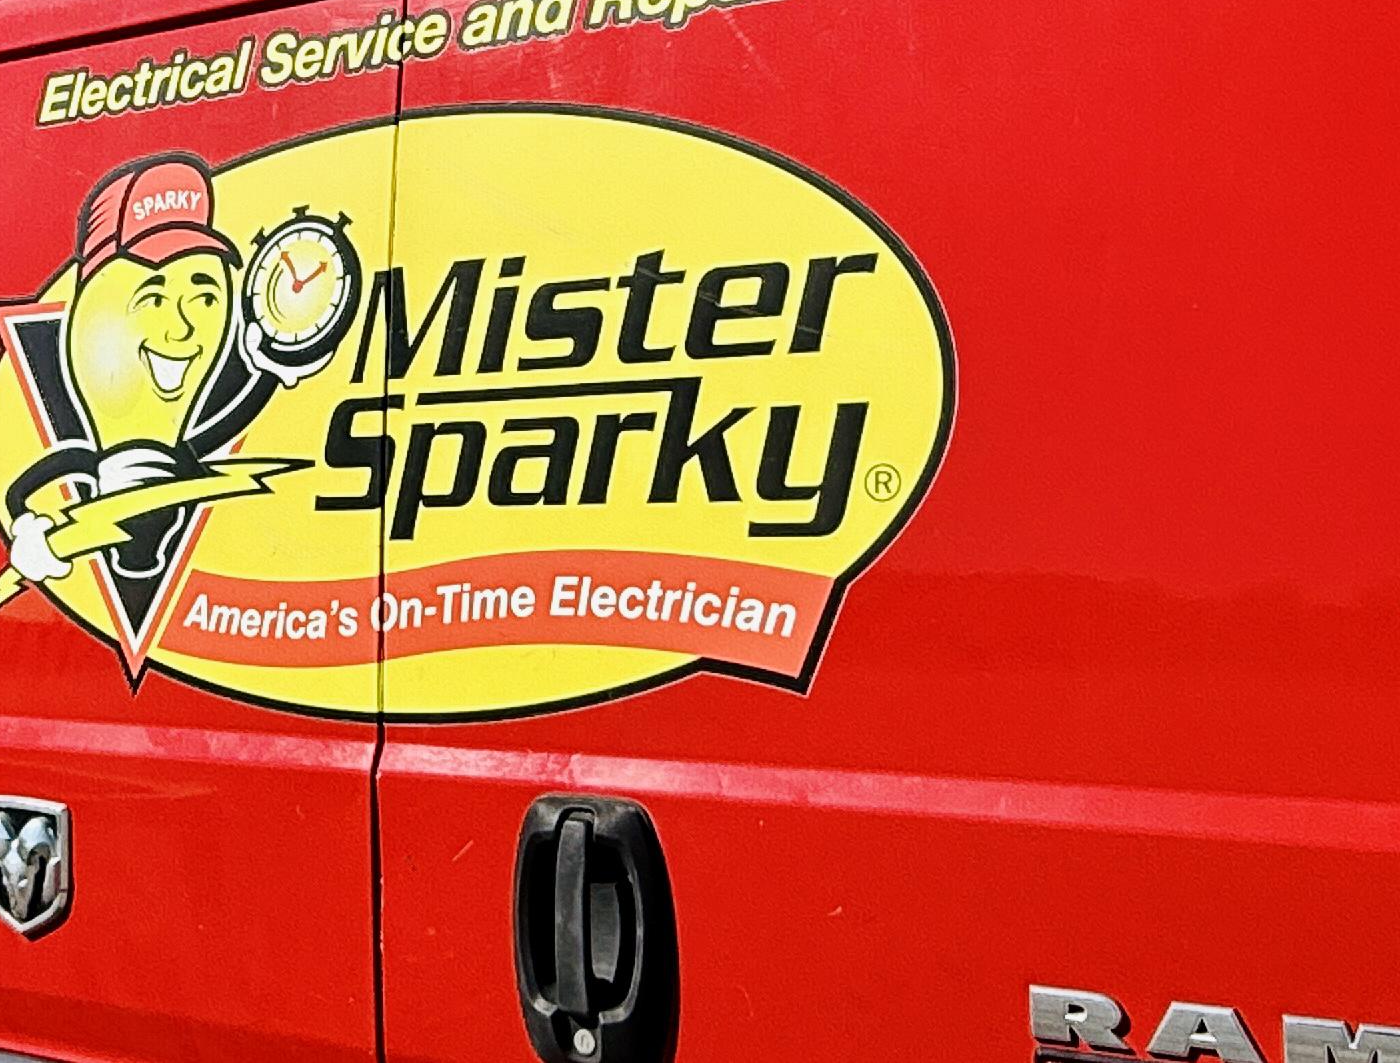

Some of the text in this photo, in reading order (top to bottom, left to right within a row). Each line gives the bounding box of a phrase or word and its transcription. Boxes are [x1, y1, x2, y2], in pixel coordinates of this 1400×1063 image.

[38, 37, 253, 125] Electrical
[261, 13, 447, 86] Service
[131, 189, 203, 221] SPARKY
[350, 249, 879, 385] Mister
[314, 376, 870, 540] Sparky
[371, 580, 535, 634] On-Time
[549, 575, 798, 638] Electrician
[1029, 983, 1400, 1063] RAM
